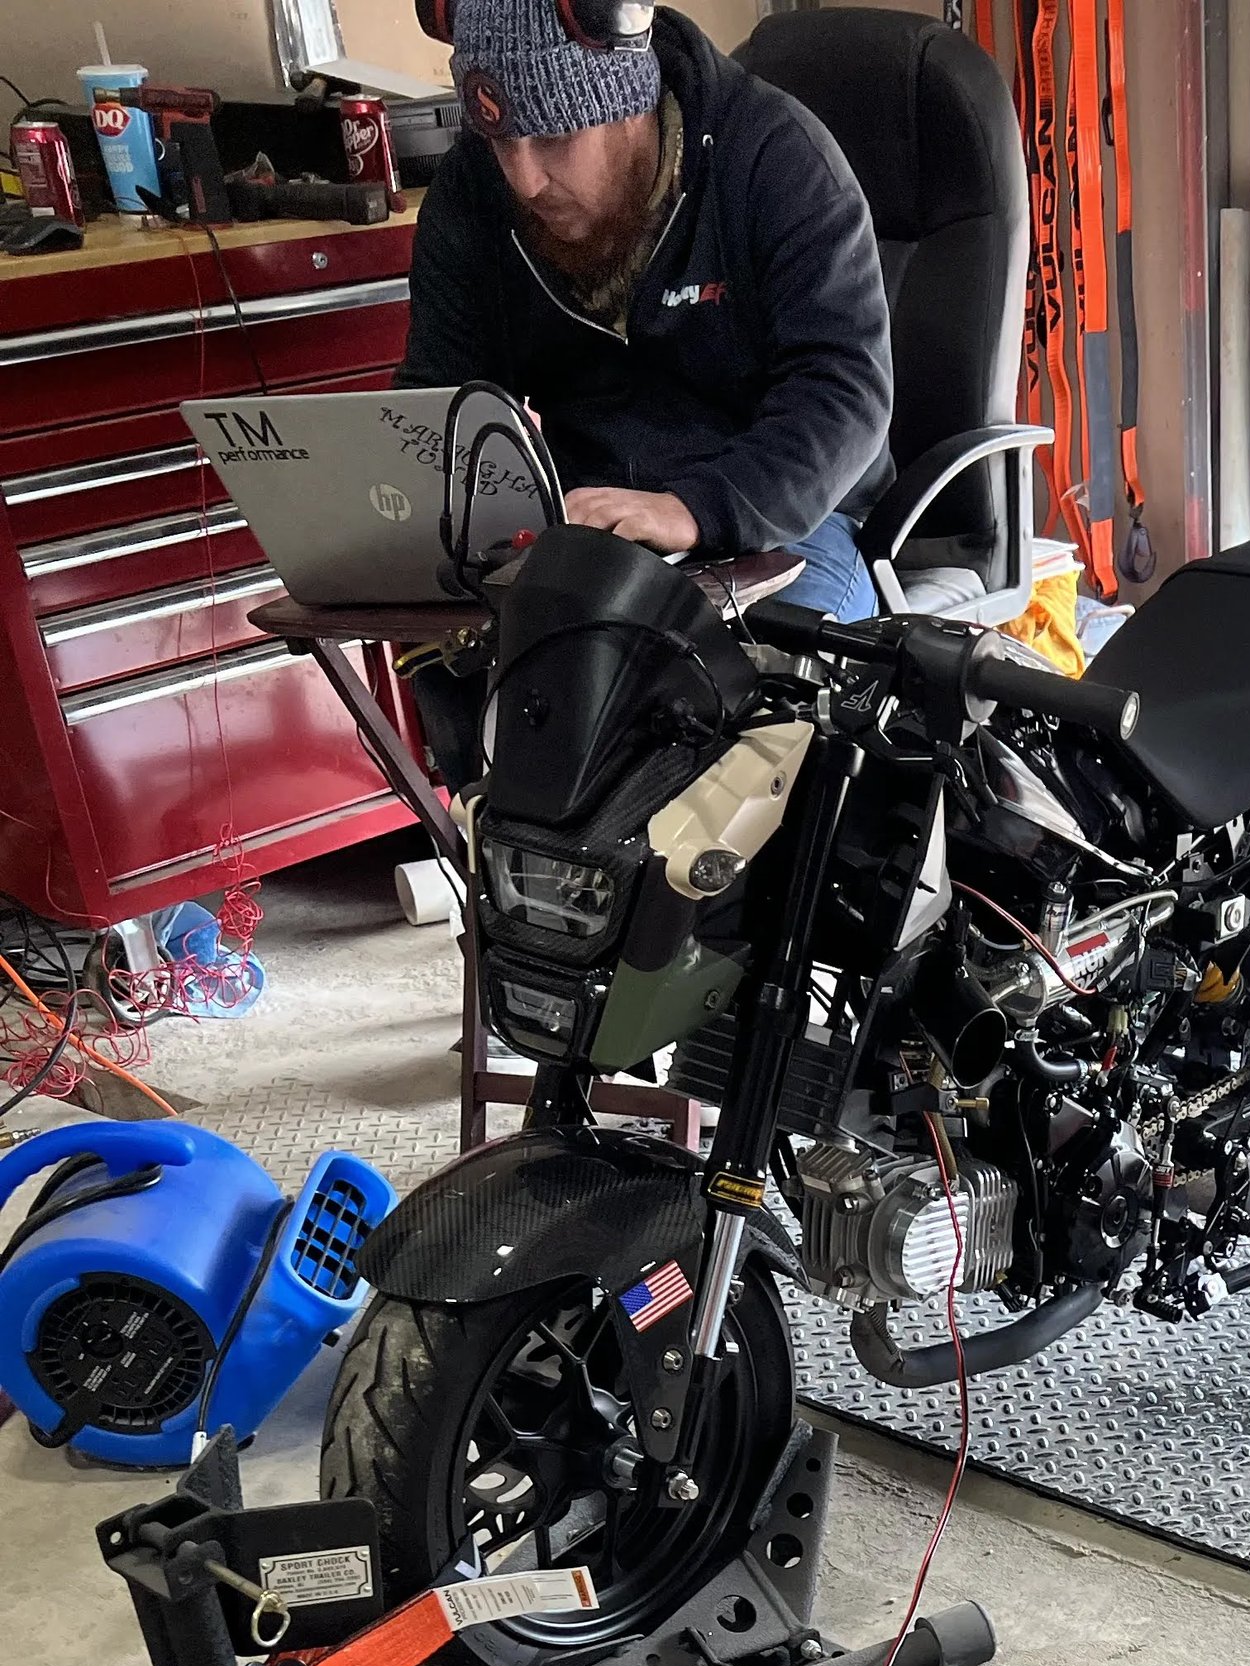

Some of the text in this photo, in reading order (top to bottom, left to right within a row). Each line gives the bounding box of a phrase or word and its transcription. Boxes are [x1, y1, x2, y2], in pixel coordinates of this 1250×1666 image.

[95, 109, 124, 130] DQ
[1038, 110, 1061, 333] VULCAN
[204, 410, 284, 448] TM
[217, 446, 311, 465] performance
[375, 484, 407, 520] hp
[280, 1560, 314, 1572] SPORT
[317, 1555, 351, 1567] CHOCK
[309, 1571, 342, 1580] TRAILER
[443, 1589, 463, 1626] VULCAN
